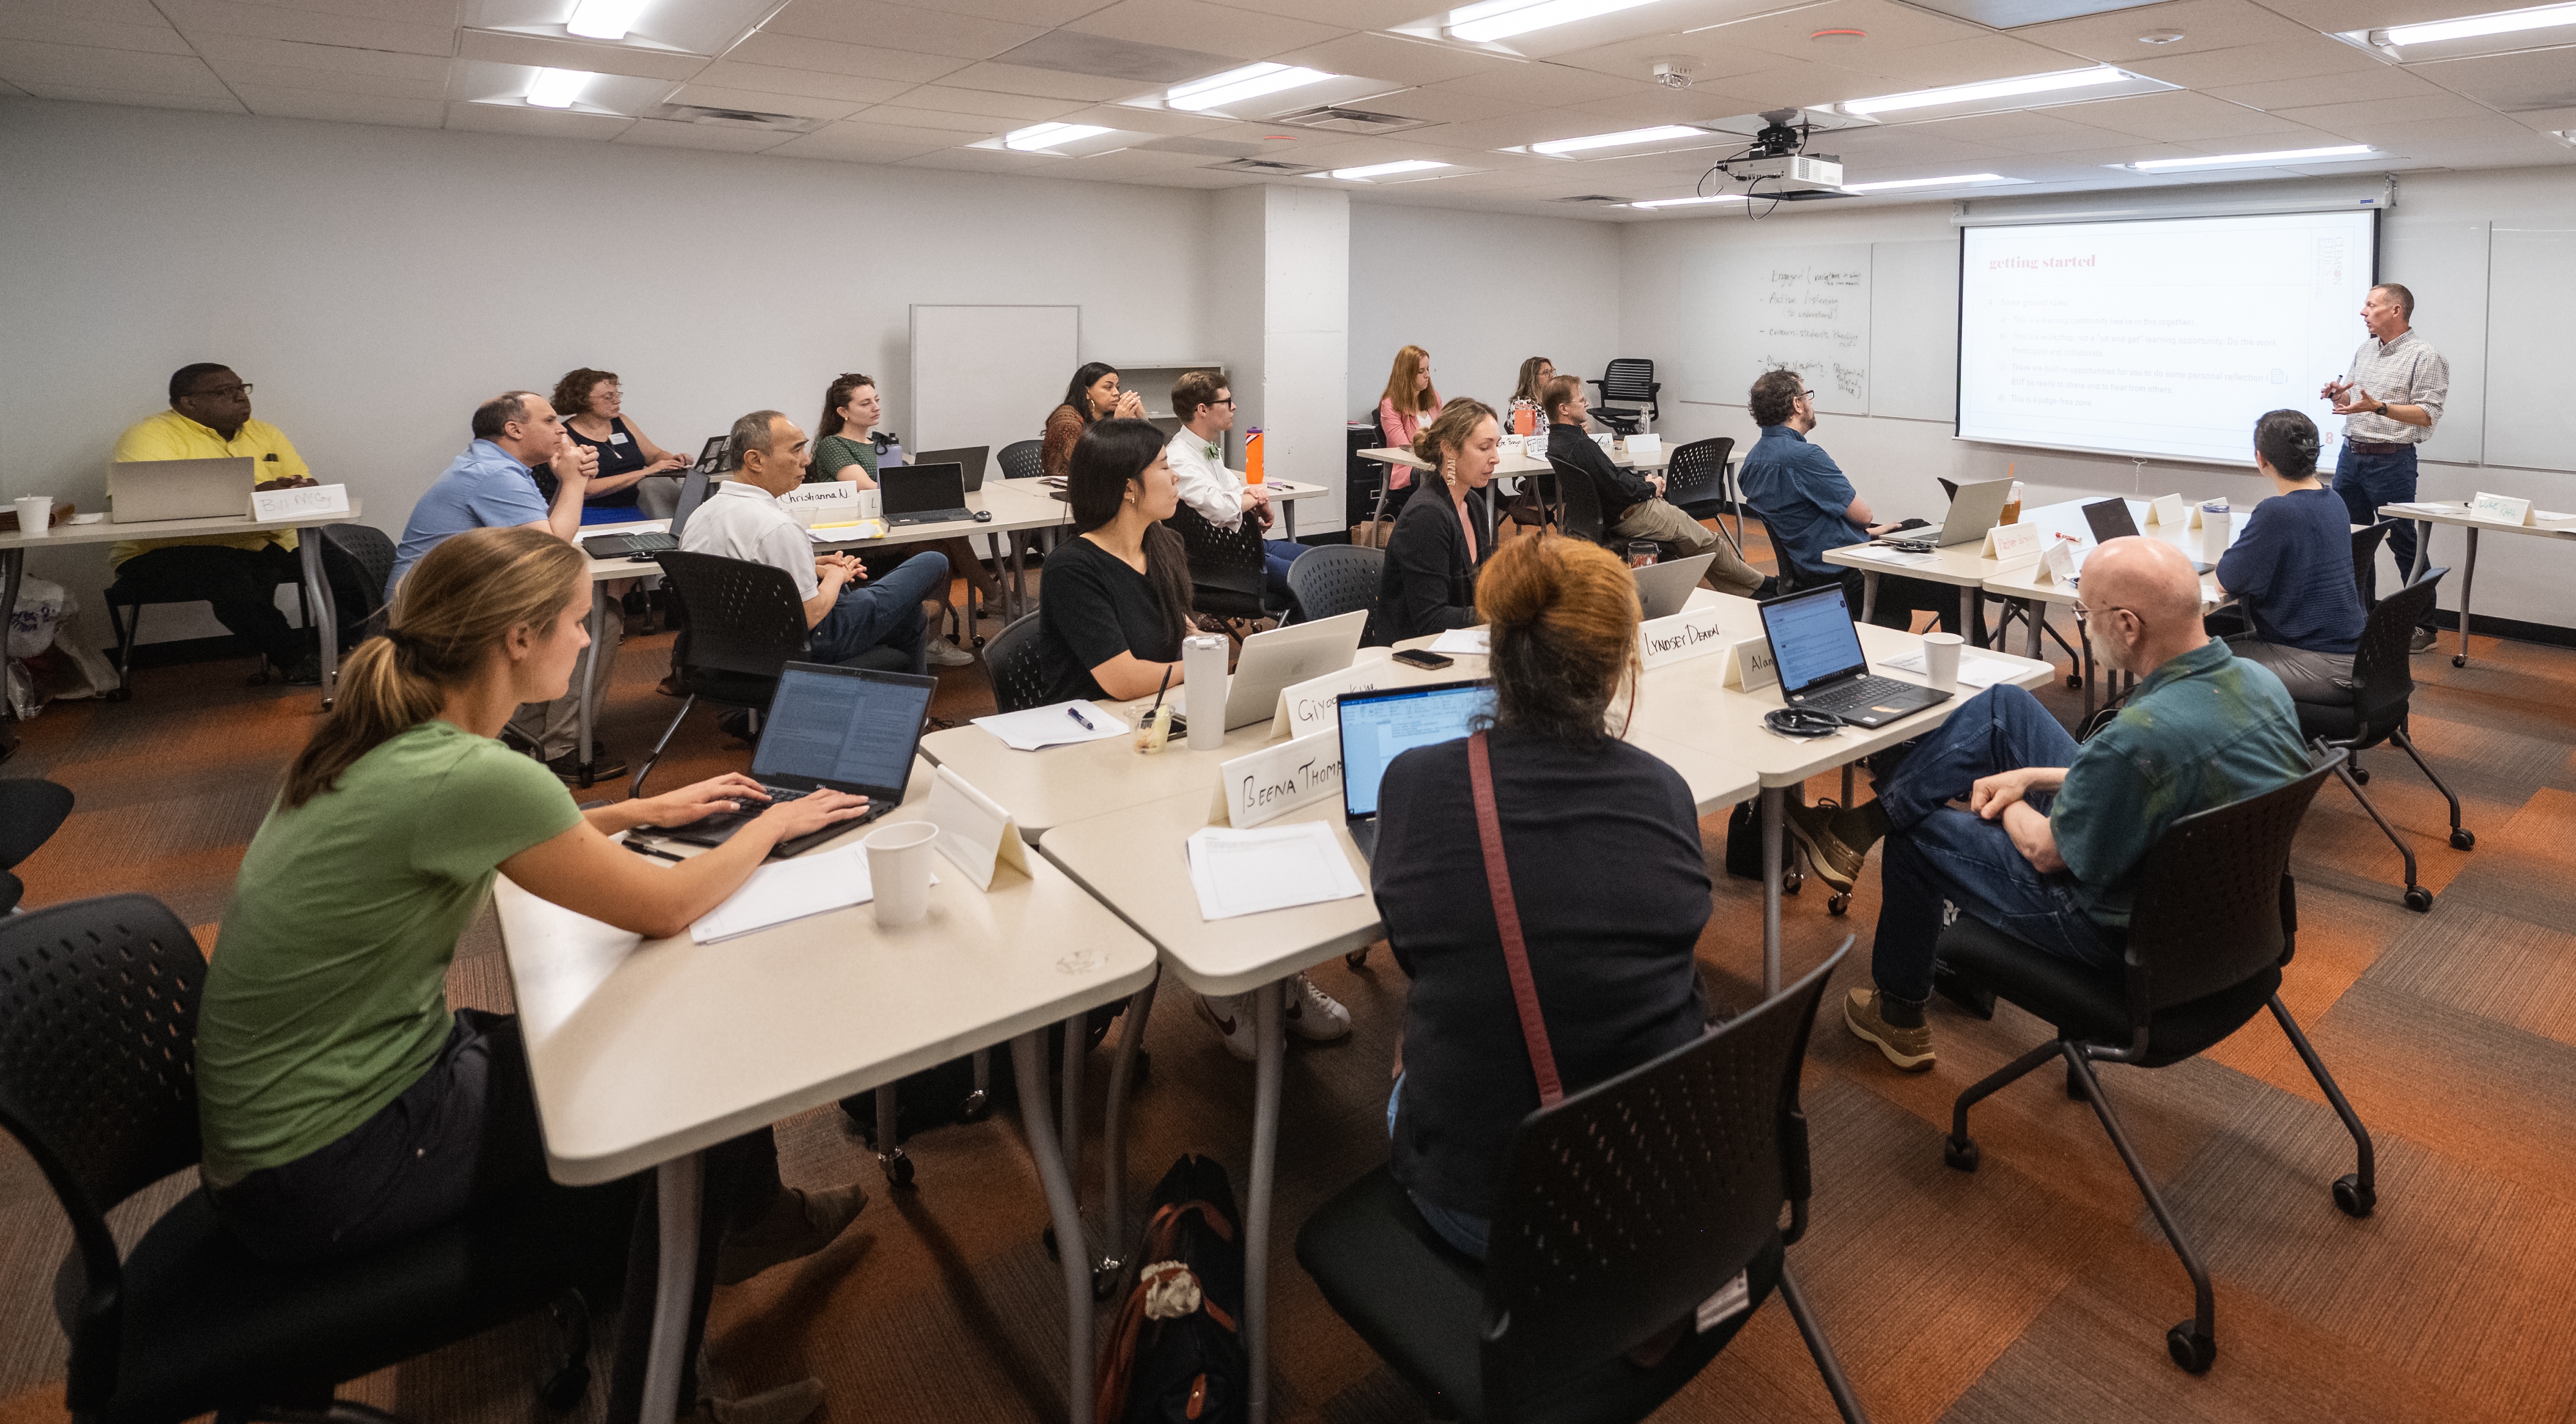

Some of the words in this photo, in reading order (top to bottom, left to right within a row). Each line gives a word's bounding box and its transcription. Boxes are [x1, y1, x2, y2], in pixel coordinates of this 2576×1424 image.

[1671, 66, 1691, 75] ALERT
[1990, 256, 2039, 270] getting
[2043, 255, 2095, 267] started
[1770, 292, 1795, 304] Active
[2022, 299, 2048, 308] ground
[2041, 317, 2068, 325] learning
[2071, 317, 2108, 326] community
[2145, 336, 2175, 345] learning
[2179, 337, 2225, 347] opportunity.
[2228, 337, 2238, 346] Do
[2070, 367, 2115, 375] opportunities
[2225, 373, 2263, 381] reflection
[2148, 385, 2173, 394] others.
[2038, 397, 2073, 405] judge-free
[2325, 432, 2333, 444] 8
[260, 499, 289, 512] Bill
[2479, 500, 2500, 510] LUKE
[1998, 538, 2016, 551] Peter
[1298, 756, 1343, 790] THOMA
